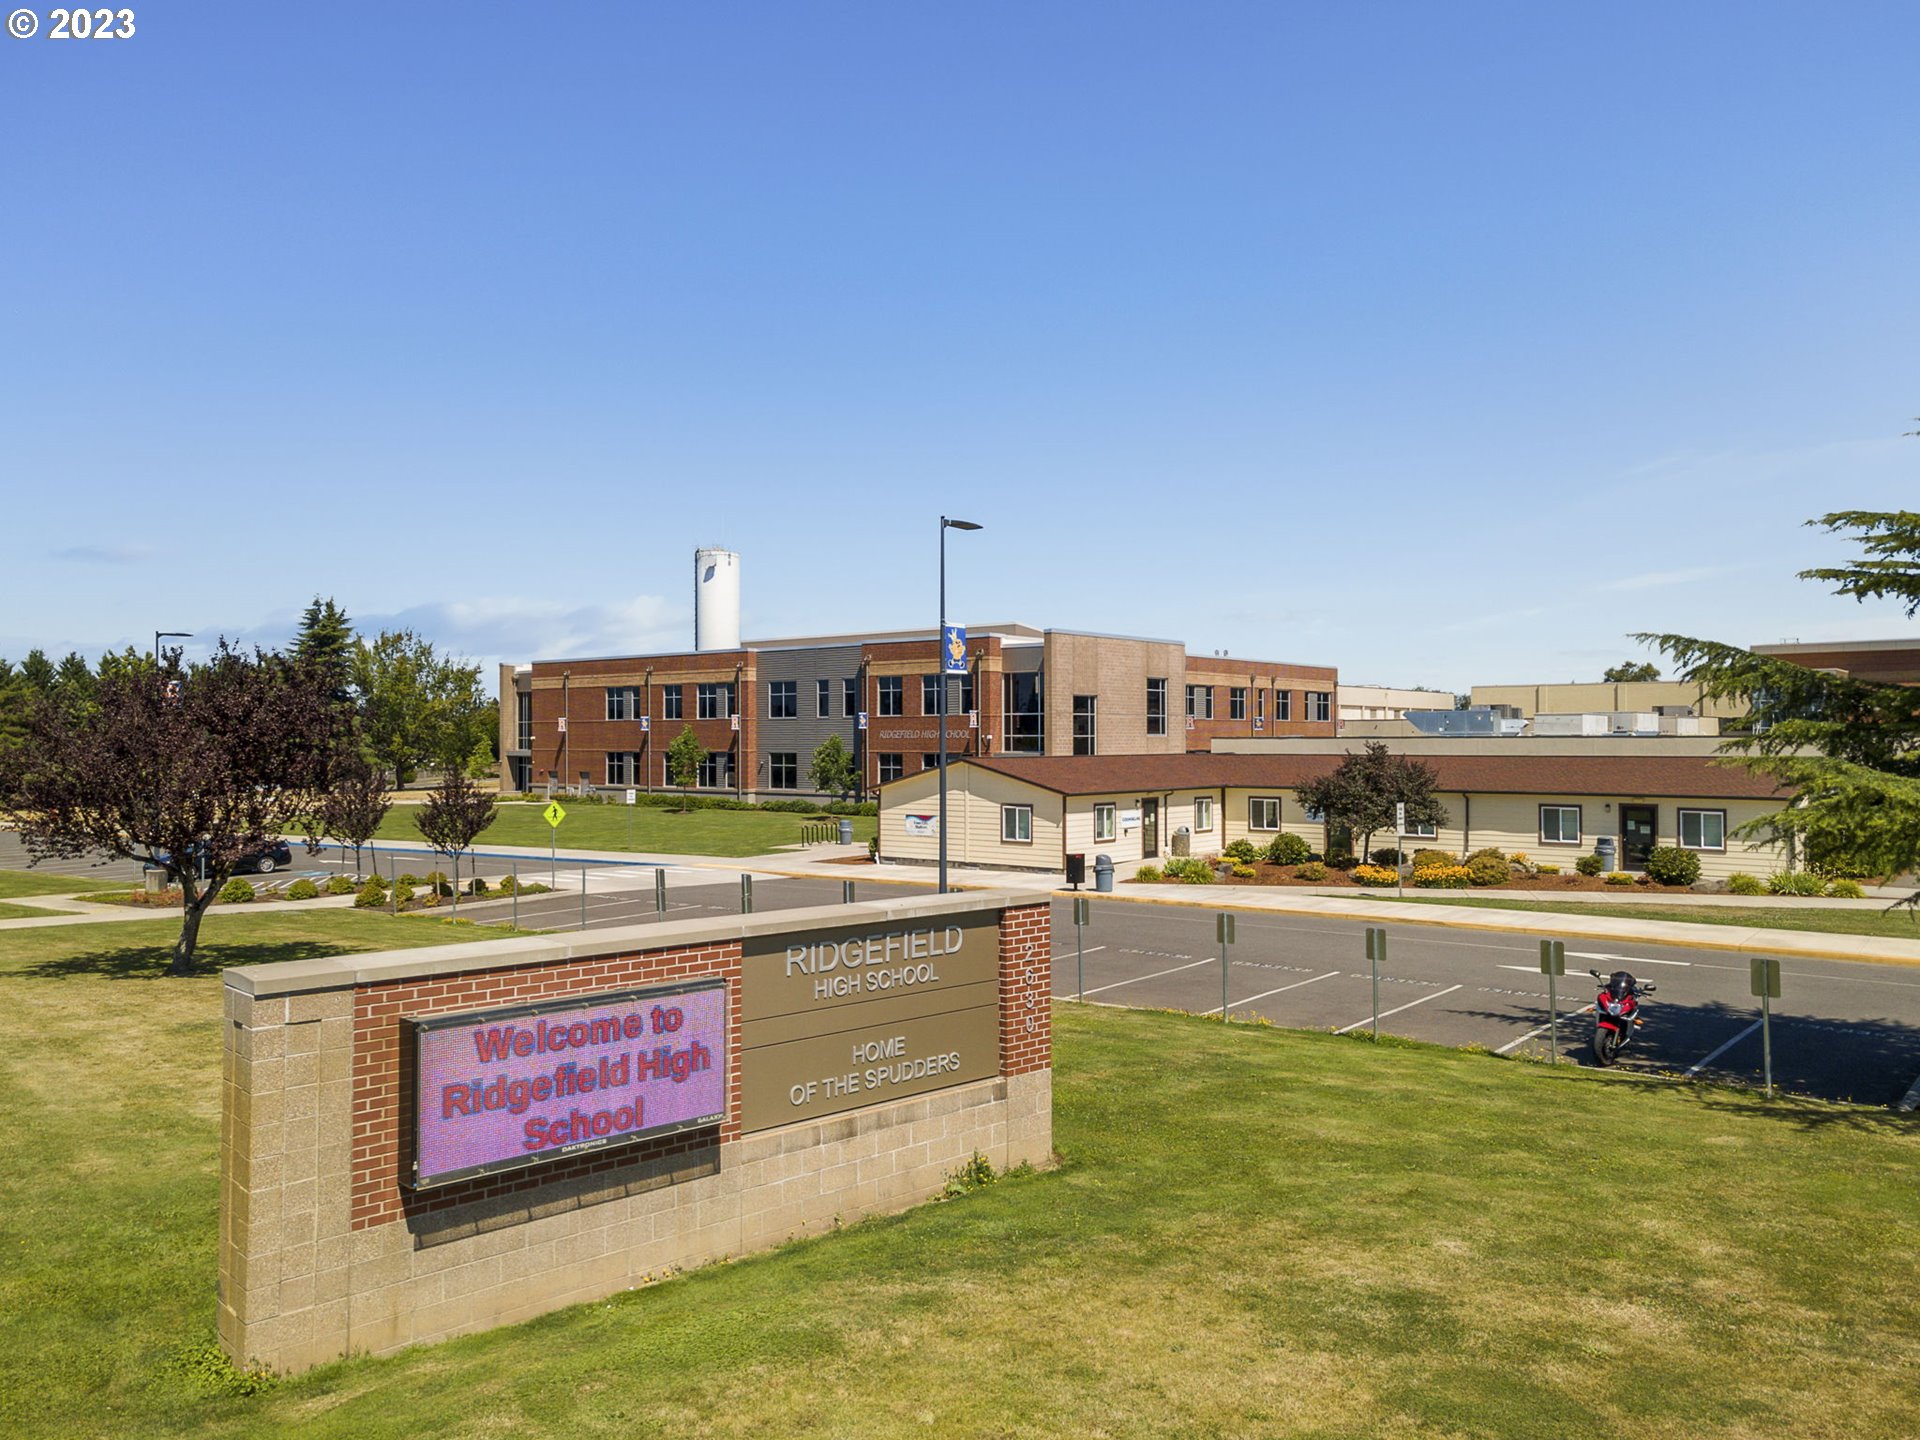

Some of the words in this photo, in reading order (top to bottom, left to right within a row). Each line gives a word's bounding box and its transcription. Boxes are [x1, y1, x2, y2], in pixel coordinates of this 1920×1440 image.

[879, 728, 920, 739] RIDGEFIELD
[921, 729, 940, 739] HIGH
[945, 729, 971, 739] CHOOL
[785, 925, 964, 976] RIDGEFIELD
[814, 974, 860, 1001] HIGH
[866, 963, 939, 993] SCHOOL
[473, 1016, 644, 1064] Welcome
[651, 1004, 684, 1035] to
[852, 1036, 906, 1065] HOME
[441, 1052, 631, 1121] Ridgefield
[637, 1040, 712, 1083] High
[789, 1082, 817, 1106] OF
[822, 1072, 860, 1098] THE
[864, 1052, 961, 1089] SPUDDERS
[523, 1095, 646, 1152] School
